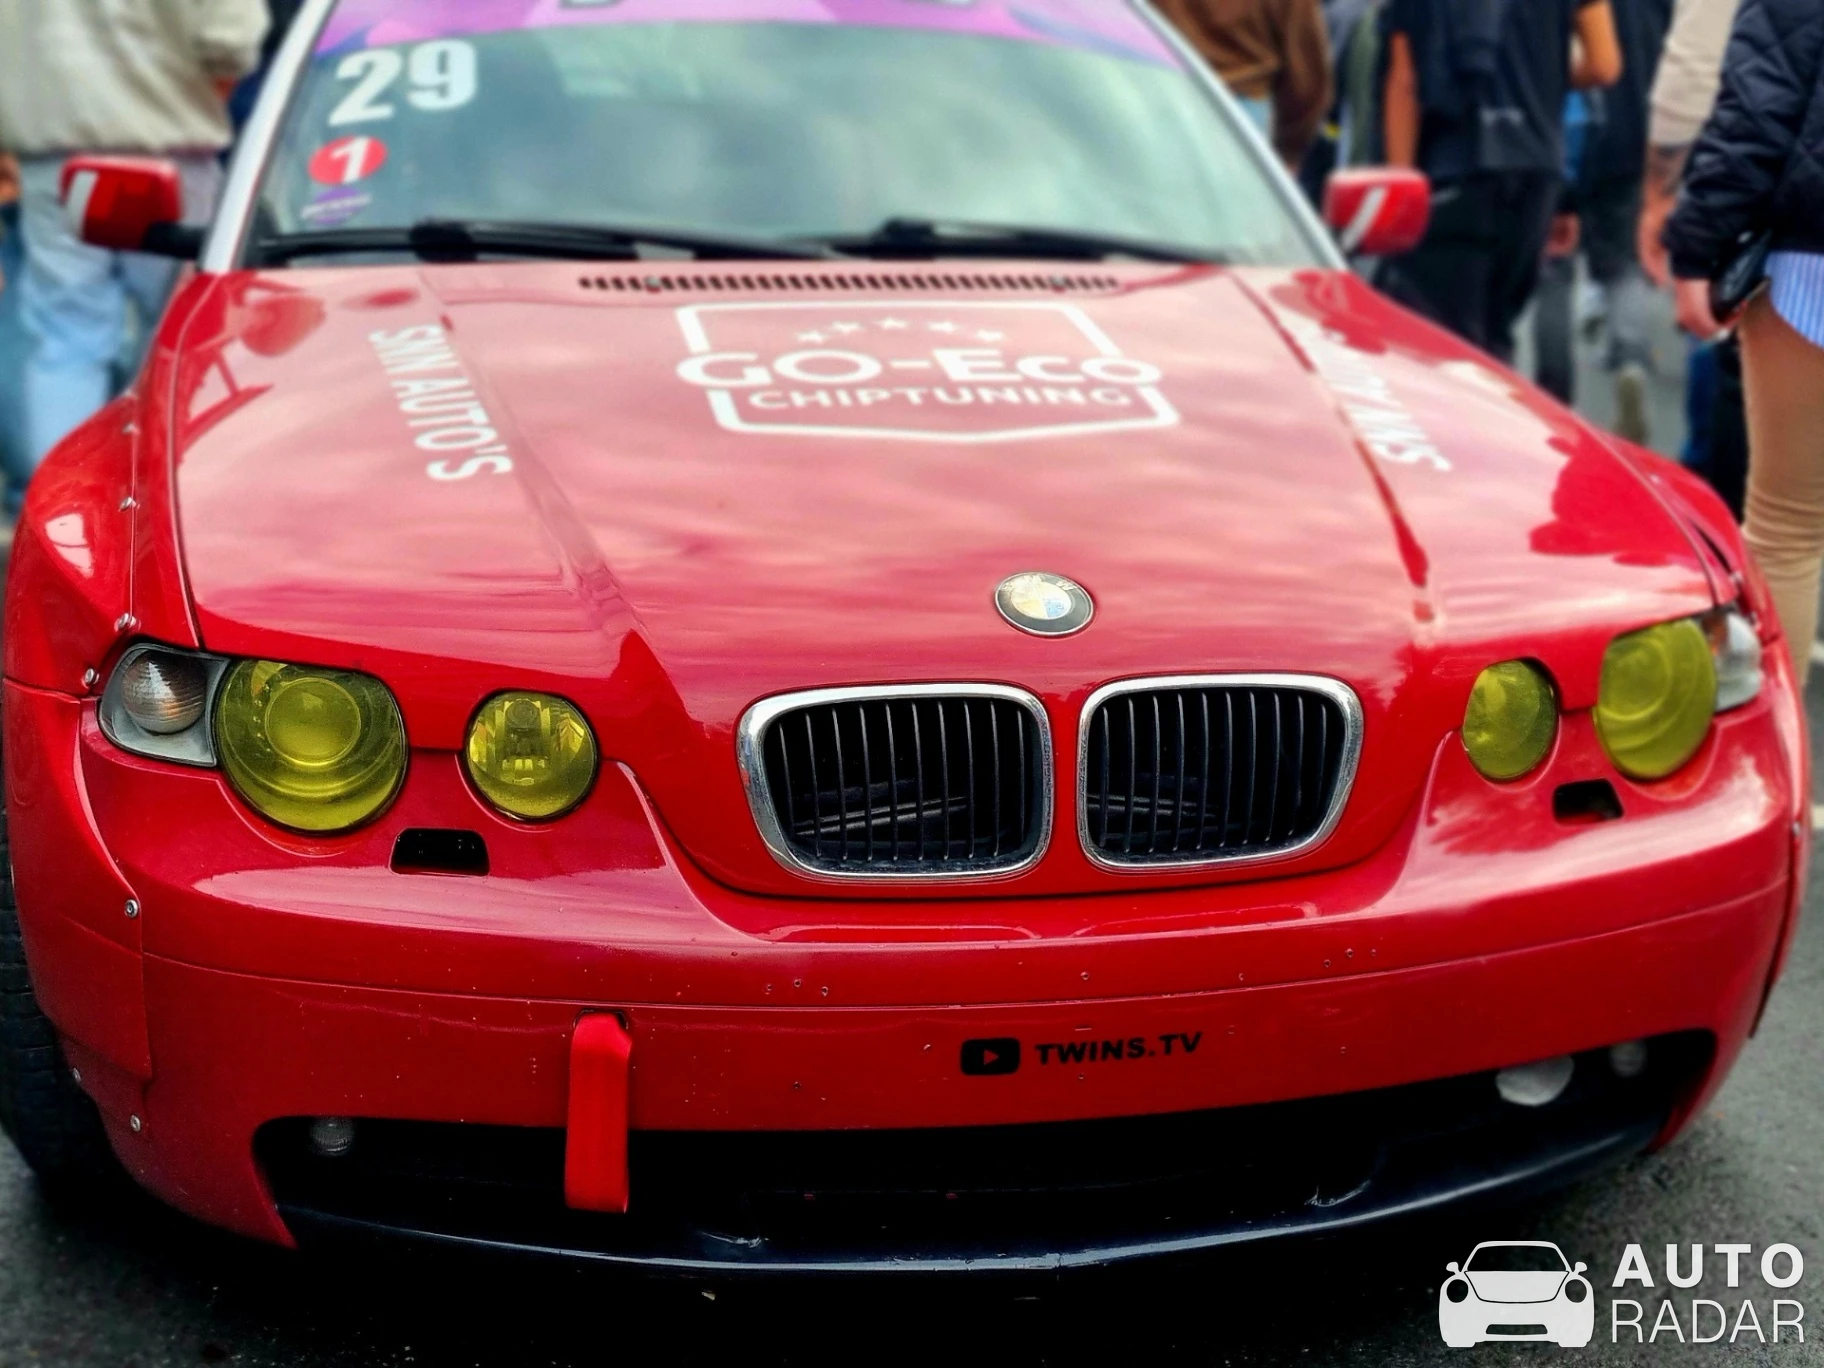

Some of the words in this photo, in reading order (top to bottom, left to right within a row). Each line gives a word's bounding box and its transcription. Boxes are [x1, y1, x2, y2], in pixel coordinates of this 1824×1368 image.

[328, 39, 477, 126] 29
[331, 137, 370, 184] 1
[749, 386, 1132, 410] CHIPTUNING
[390, 377, 513, 480] AUTO'S
[1034, 1031, 1203, 1065] TWINS.TV
